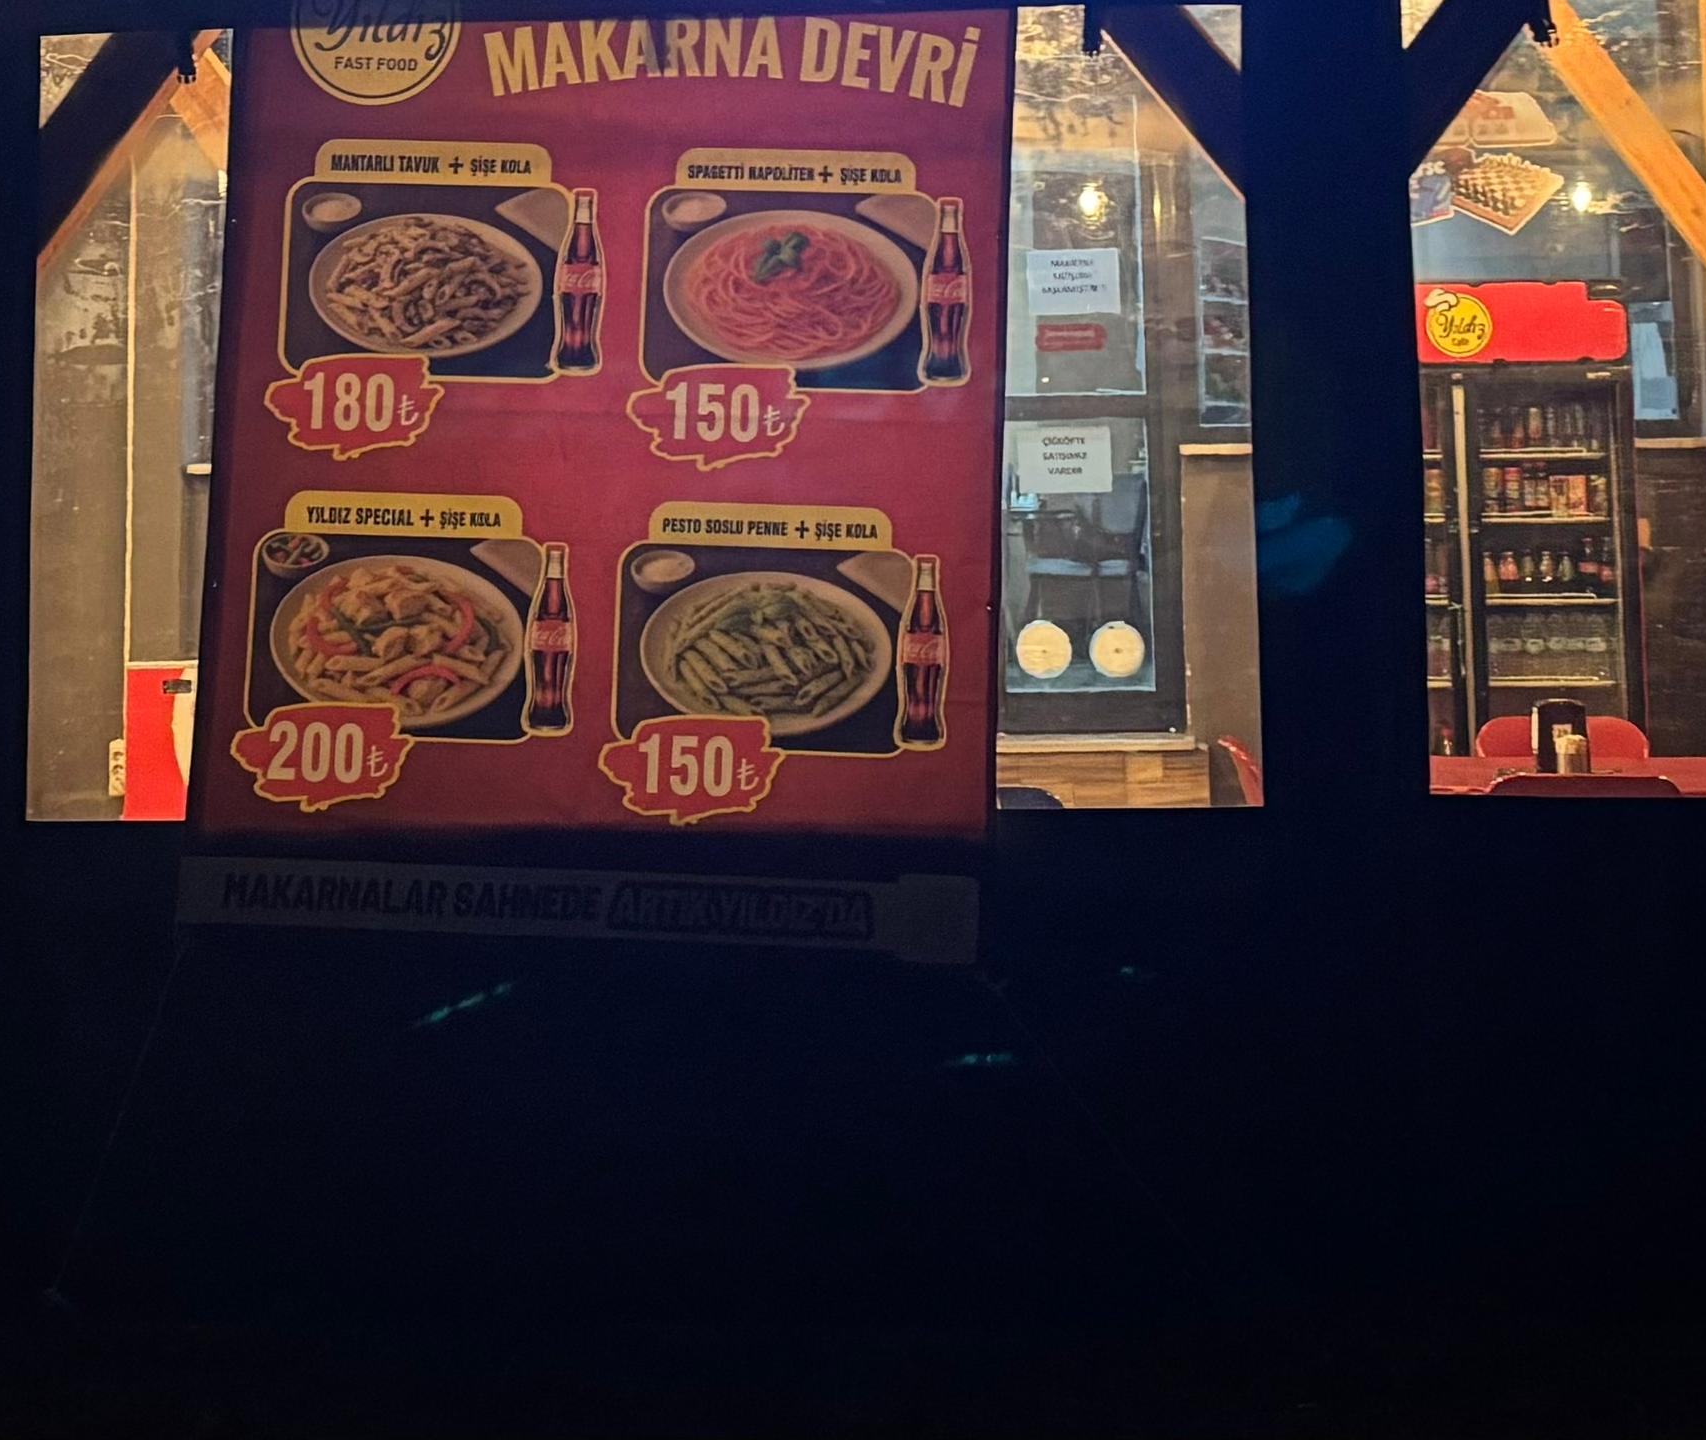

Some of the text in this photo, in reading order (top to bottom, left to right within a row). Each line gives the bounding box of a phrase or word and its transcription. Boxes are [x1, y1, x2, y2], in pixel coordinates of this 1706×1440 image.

[334, 57, 417, 71] FAST FOOD
[484, 15, 981, 108] MAKARNA DEVRİ
[331, 154, 531, 176] MANTARLI TAVUK + ŞİŞE KOLA
[818, 166, 833, 182] +
[871, 168, 901, 183] KOLA
[303, 372, 419, 432] 180₺
[665, 382, 785, 442] 150₺
[307, 506, 350, 524] YILDIZ
[355, 508, 414, 526] SPECIAL
[420, 509, 434, 527] +
[439, 508, 466, 529] ŞİŞE
[663, 518, 878, 540] PESTO SOSLU PENNE + ŞİŞE KOLA
[266, 720, 388, 783] 200₺
[639, 733, 759, 797] 150₺
[222, 871, 445, 916] MAKARNALAR
[453, 880, 600, 921] SAHNEDE
